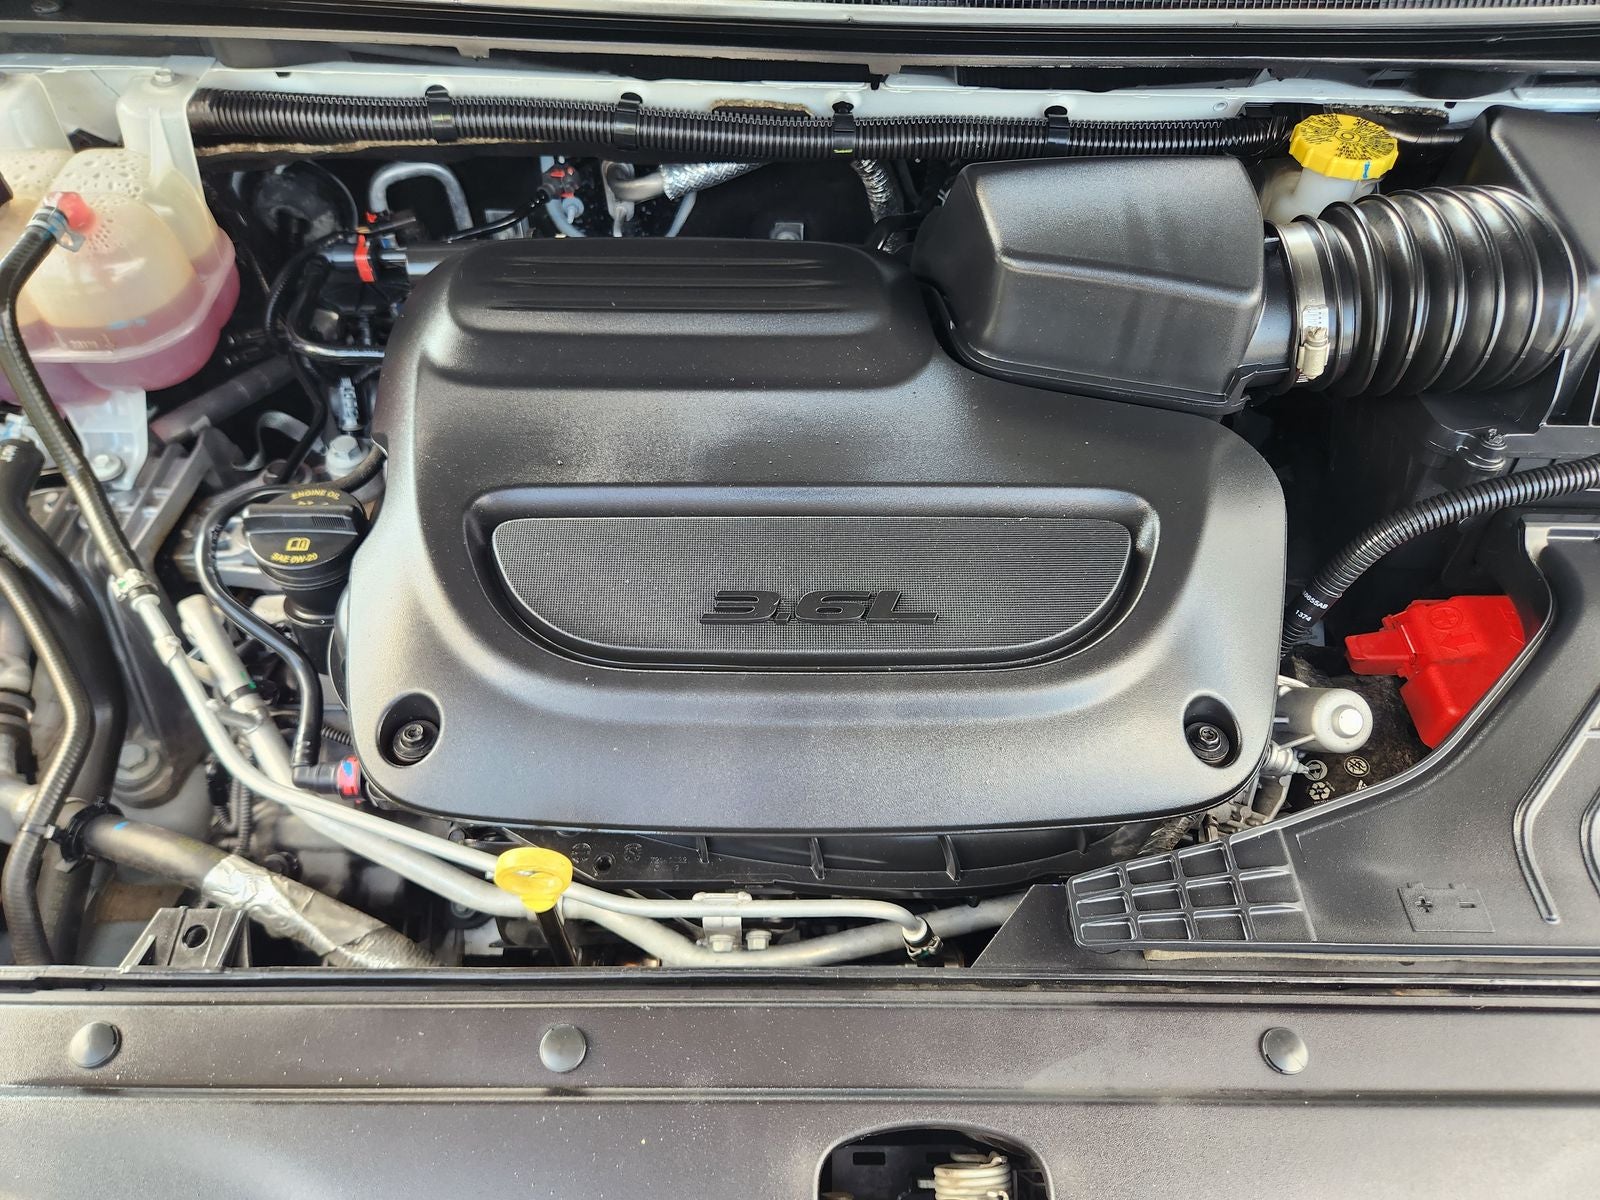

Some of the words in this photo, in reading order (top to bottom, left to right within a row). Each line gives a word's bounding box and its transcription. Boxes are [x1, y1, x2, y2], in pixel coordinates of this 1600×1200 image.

[291, 489, 326, 500] ENGINE
[327, 491, 340, 500] OIL
[271, 552, 289, 563] SAE
[700, 590, 938, 624] 3.6L
